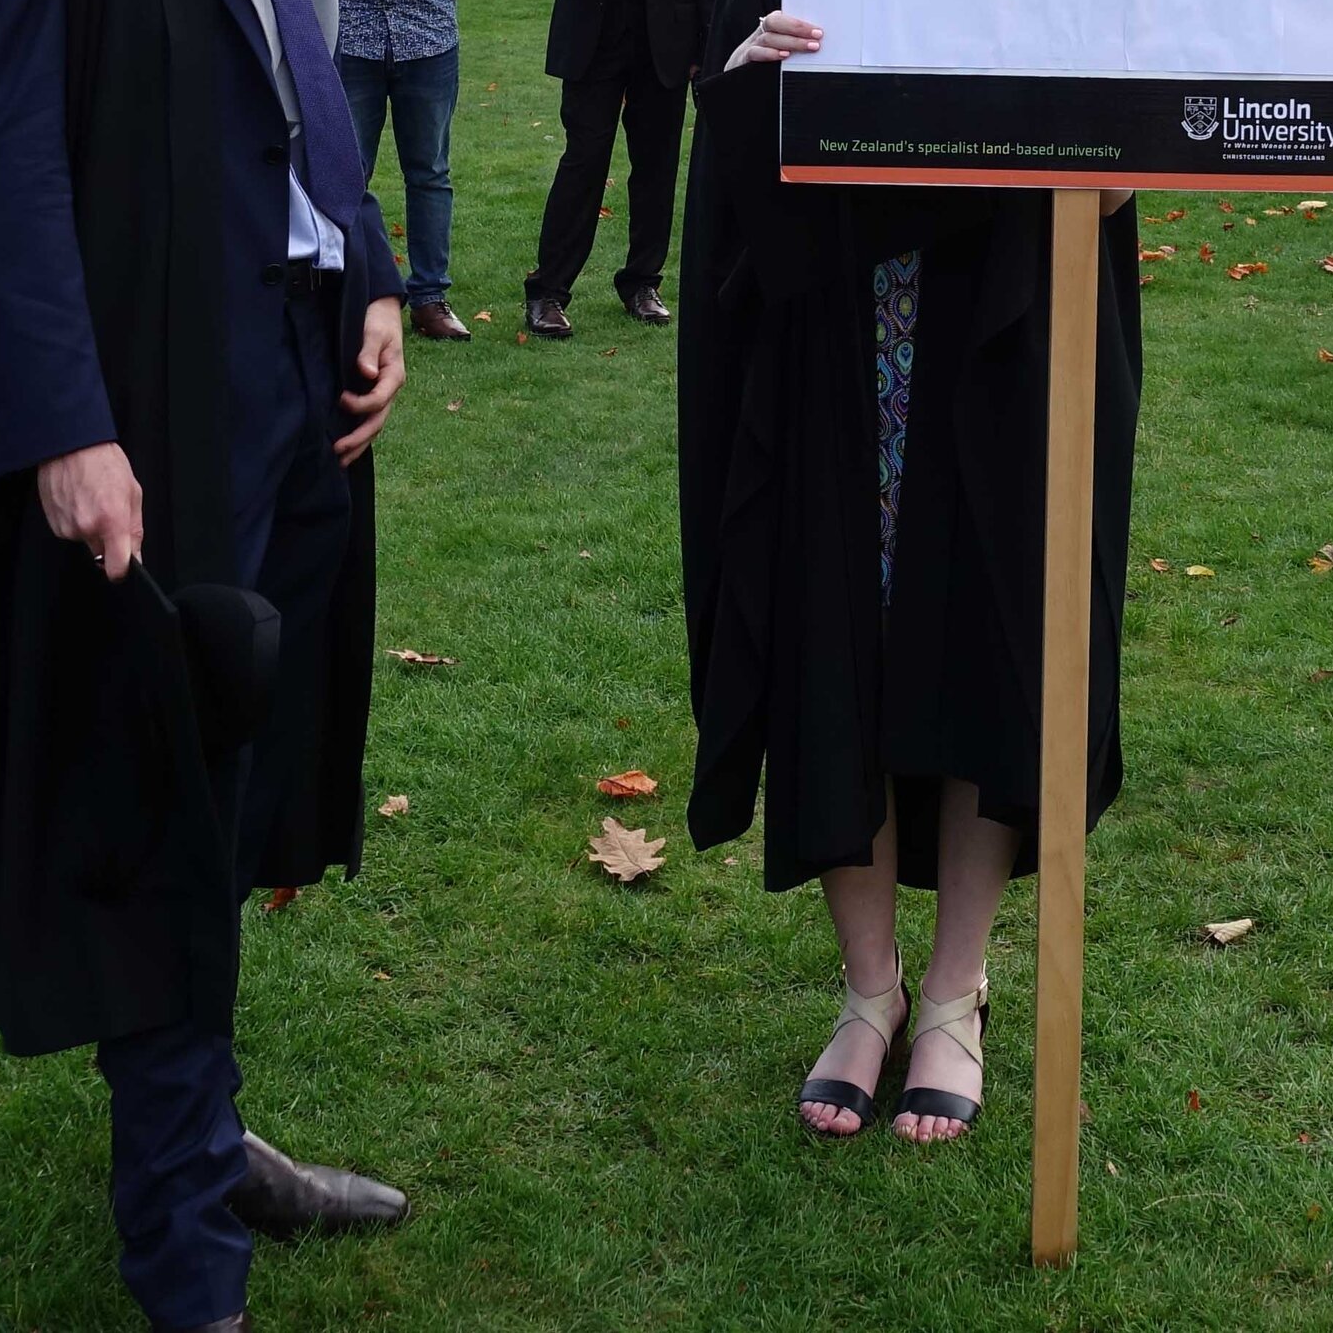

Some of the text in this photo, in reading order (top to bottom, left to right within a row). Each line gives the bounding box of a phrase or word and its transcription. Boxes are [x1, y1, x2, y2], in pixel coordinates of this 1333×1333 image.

[1223, 97, 1311, 119] Lincoln
[819, 139, 1122, 160] New Zealand's specialist land-based university
